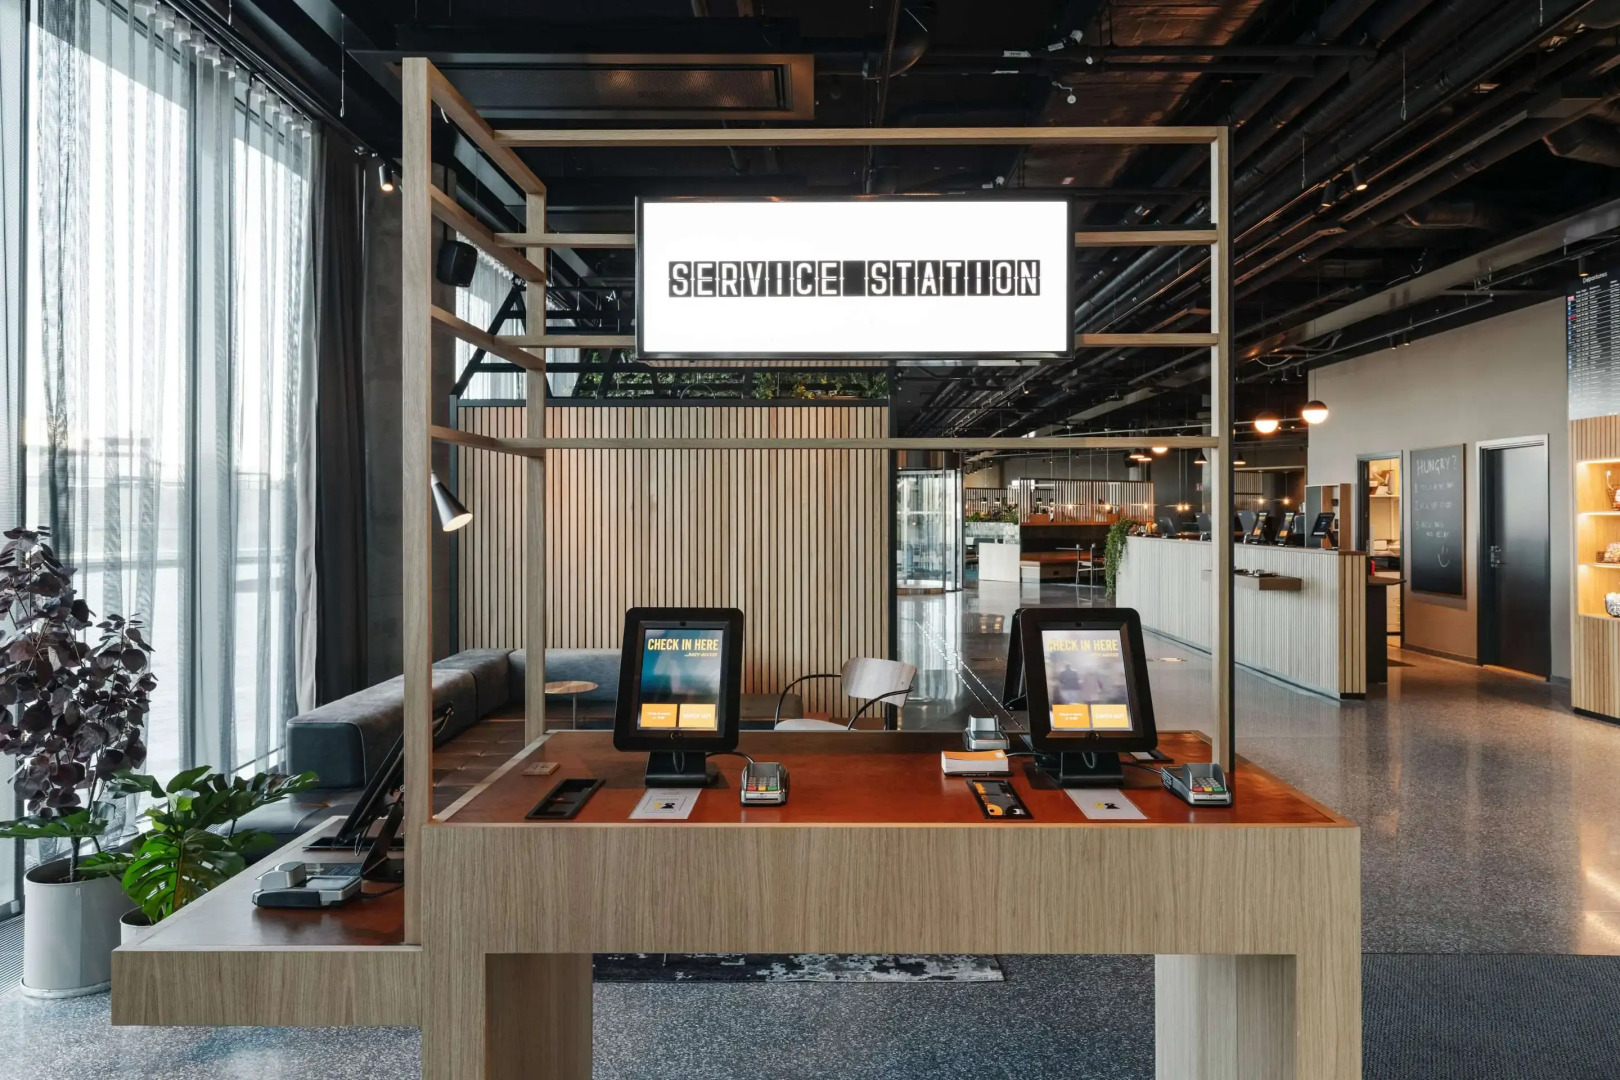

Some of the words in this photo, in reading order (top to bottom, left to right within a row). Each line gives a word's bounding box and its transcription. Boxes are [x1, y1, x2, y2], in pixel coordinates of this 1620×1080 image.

[670, 261, 840, 297] SERVICE
[869, 260, 1040, 296] STATION
[647, 638, 679, 650] CHECK
[681, 638, 692, 650] IN
[694, 638, 719, 650] HERE
[1047, 639, 1078, 651] CHECK
[1080, 639, 1091, 651] IN
[1093, 639, 1119, 651] HERE
